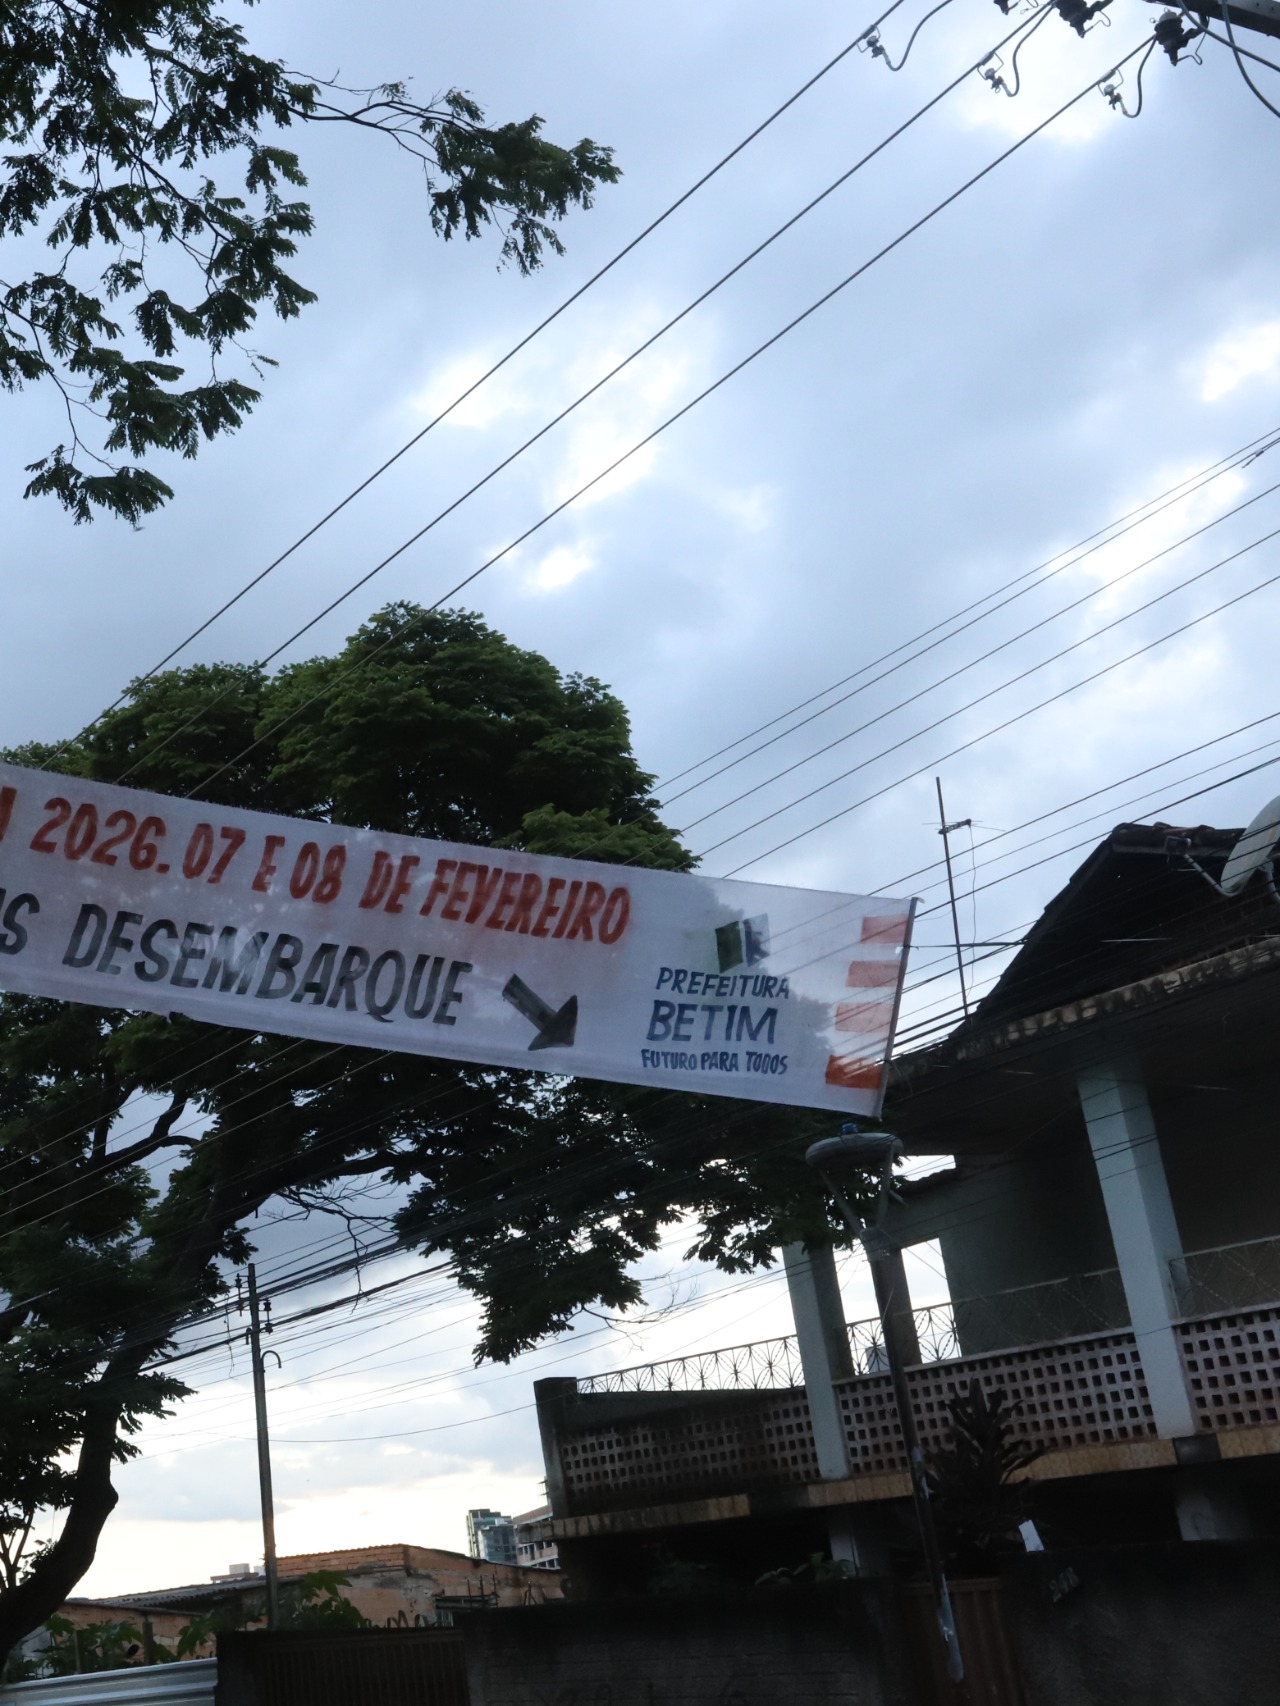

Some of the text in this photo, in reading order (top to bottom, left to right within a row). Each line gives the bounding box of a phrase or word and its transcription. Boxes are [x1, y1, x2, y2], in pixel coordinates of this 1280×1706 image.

[182, 823, 246, 884] 07
[252, 835, 285, 892] E
[289, 842, 346, 904] 08
[359, 850, 420, 914] DE
[419, 858, 631, 945] FEVEREIRO
[62, 903, 473, 1025] DESEMBARQUE
[655, 966, 790, 999] PREFEITURA
[646, 1000, 778, 1044] BETIM
[641, 1048, 788, 1075] FUTURO PARA TODOS
